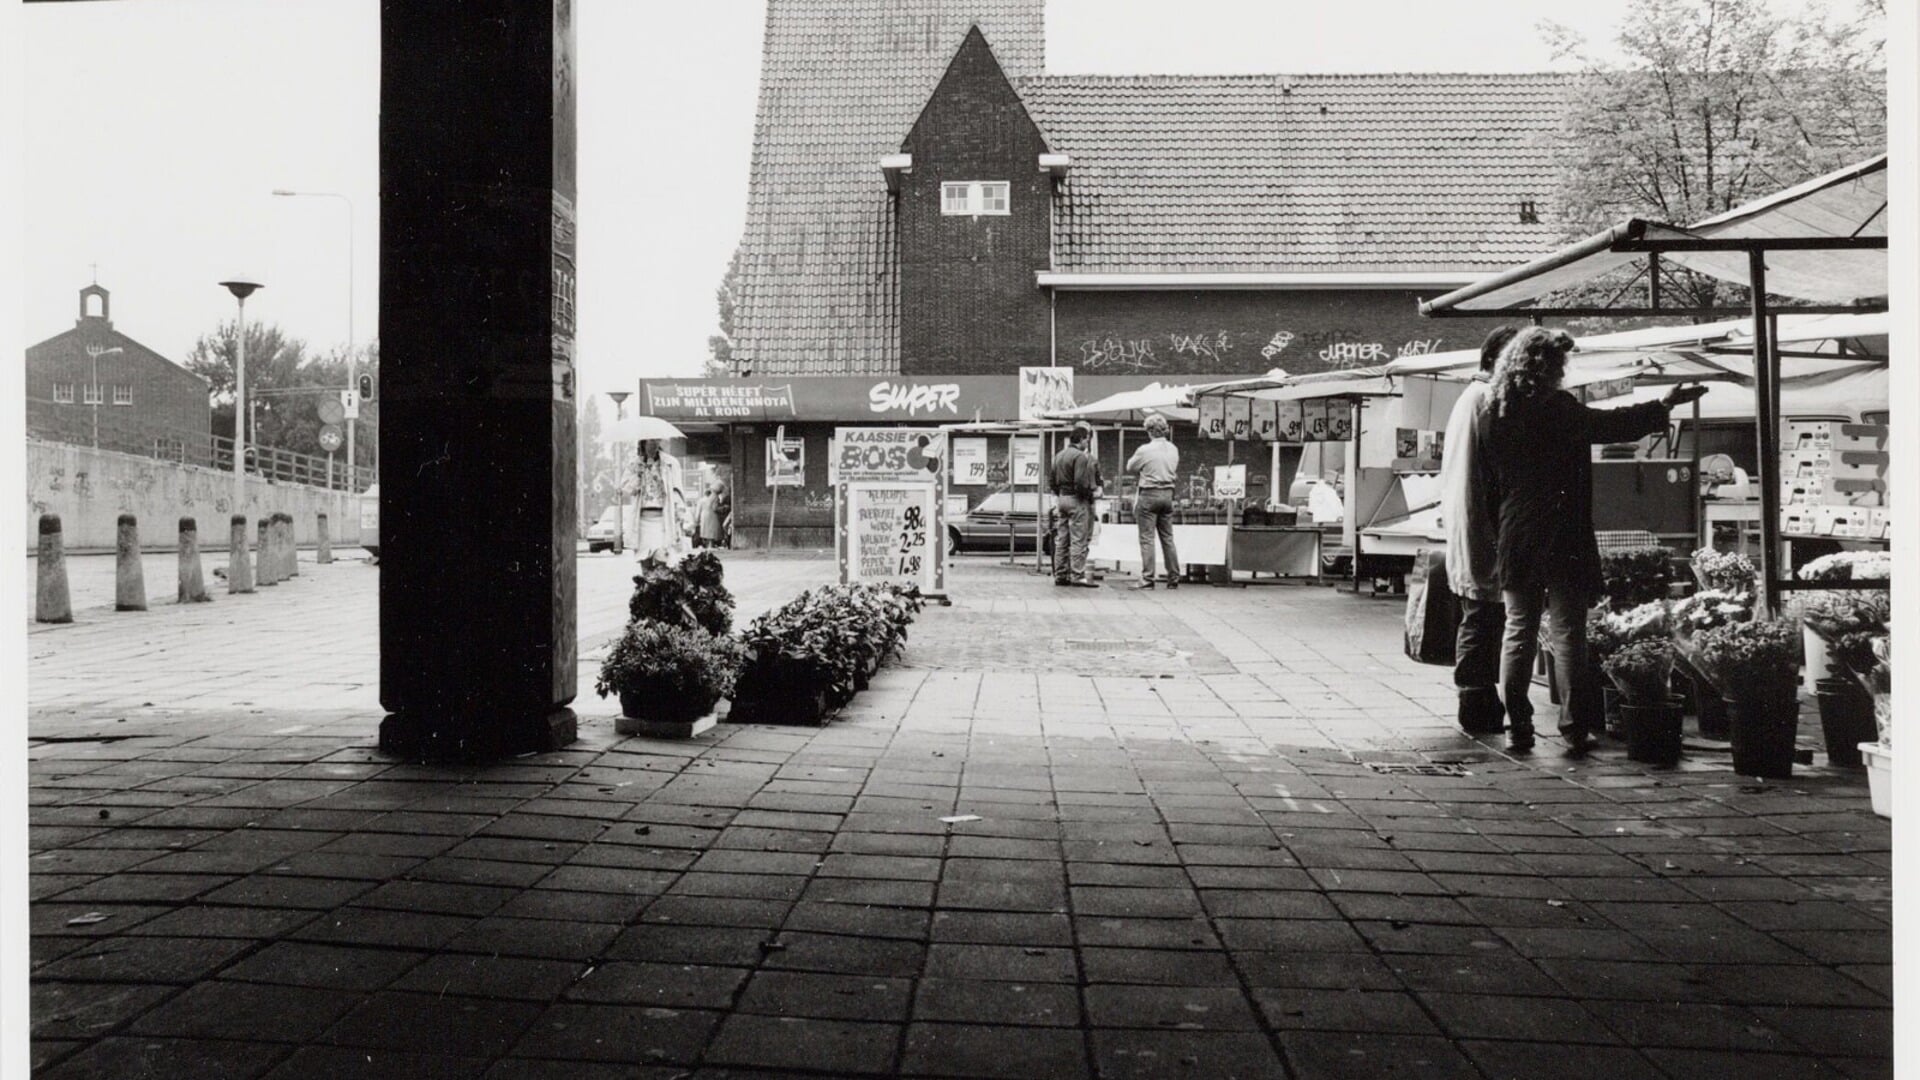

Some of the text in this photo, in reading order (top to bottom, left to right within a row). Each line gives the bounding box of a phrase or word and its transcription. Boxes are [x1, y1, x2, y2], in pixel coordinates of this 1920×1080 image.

[675, 385, 761, 397] SUPER HEEFT
[653, 396, 789, 407] ZIJN MILJOENENNOTA
[869, 381, 960, 417] SUPER
[695, 407, 751, 416] AL ROND
[844, 432, 907, 443] KAASSIE
[839, 445, 906, 470] BOS
